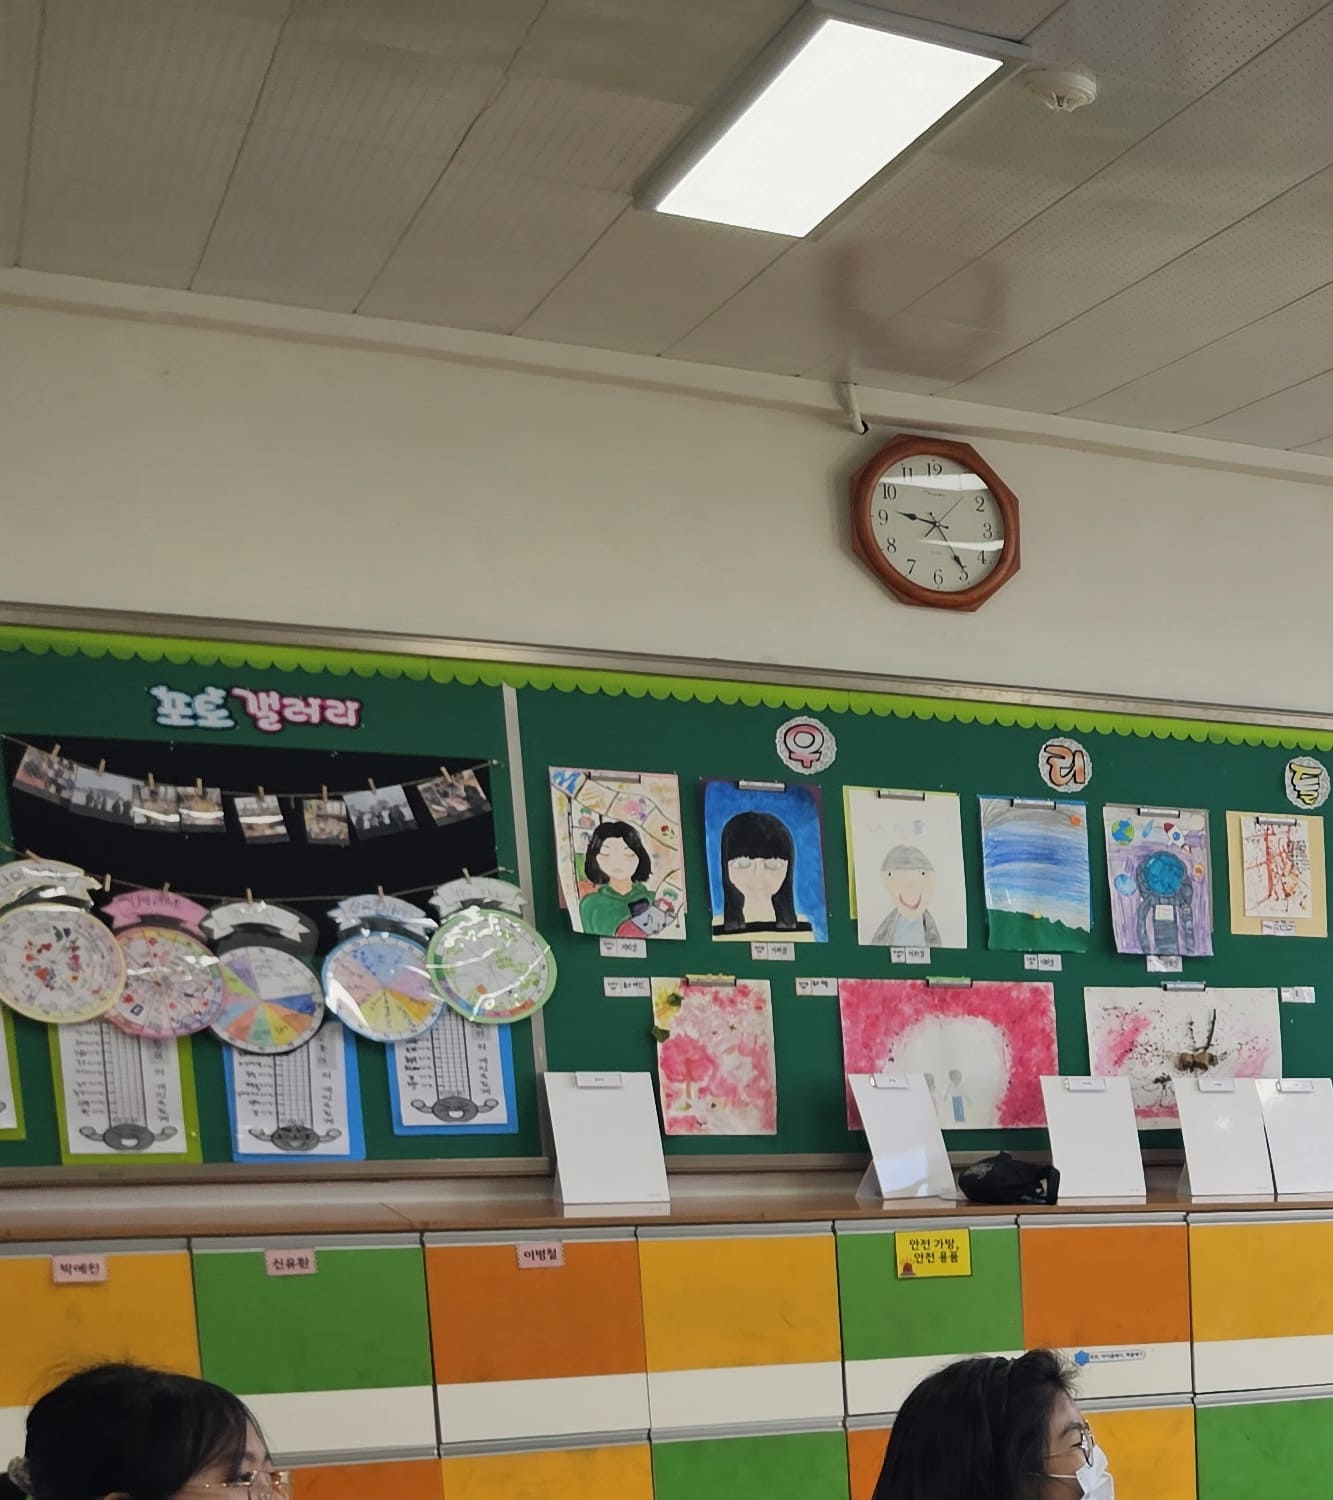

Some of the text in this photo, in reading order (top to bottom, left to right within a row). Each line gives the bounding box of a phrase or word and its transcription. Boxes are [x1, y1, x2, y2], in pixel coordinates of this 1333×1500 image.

[882, 484, 897, 500] 10
[975, 496, 986, 512] 2
[878, 510, 889, 526] 9
[983, 523, 993, 539] 3
[887, 538, 897, 554] 8
[977, 550, 987, 565] 4
[906, 559, 917, 575] 7
[933, 569, 943, 585] 6
[231, 687, 362, 732] 갤러리
[784, 724, 824, 768] 우
[1044, 745, 1086, 786] 리
[1289, 763, 1322, 806] 들
[909, 1238, 930, 1250] 안전
[914, 1252, 935, 1264] 안전
